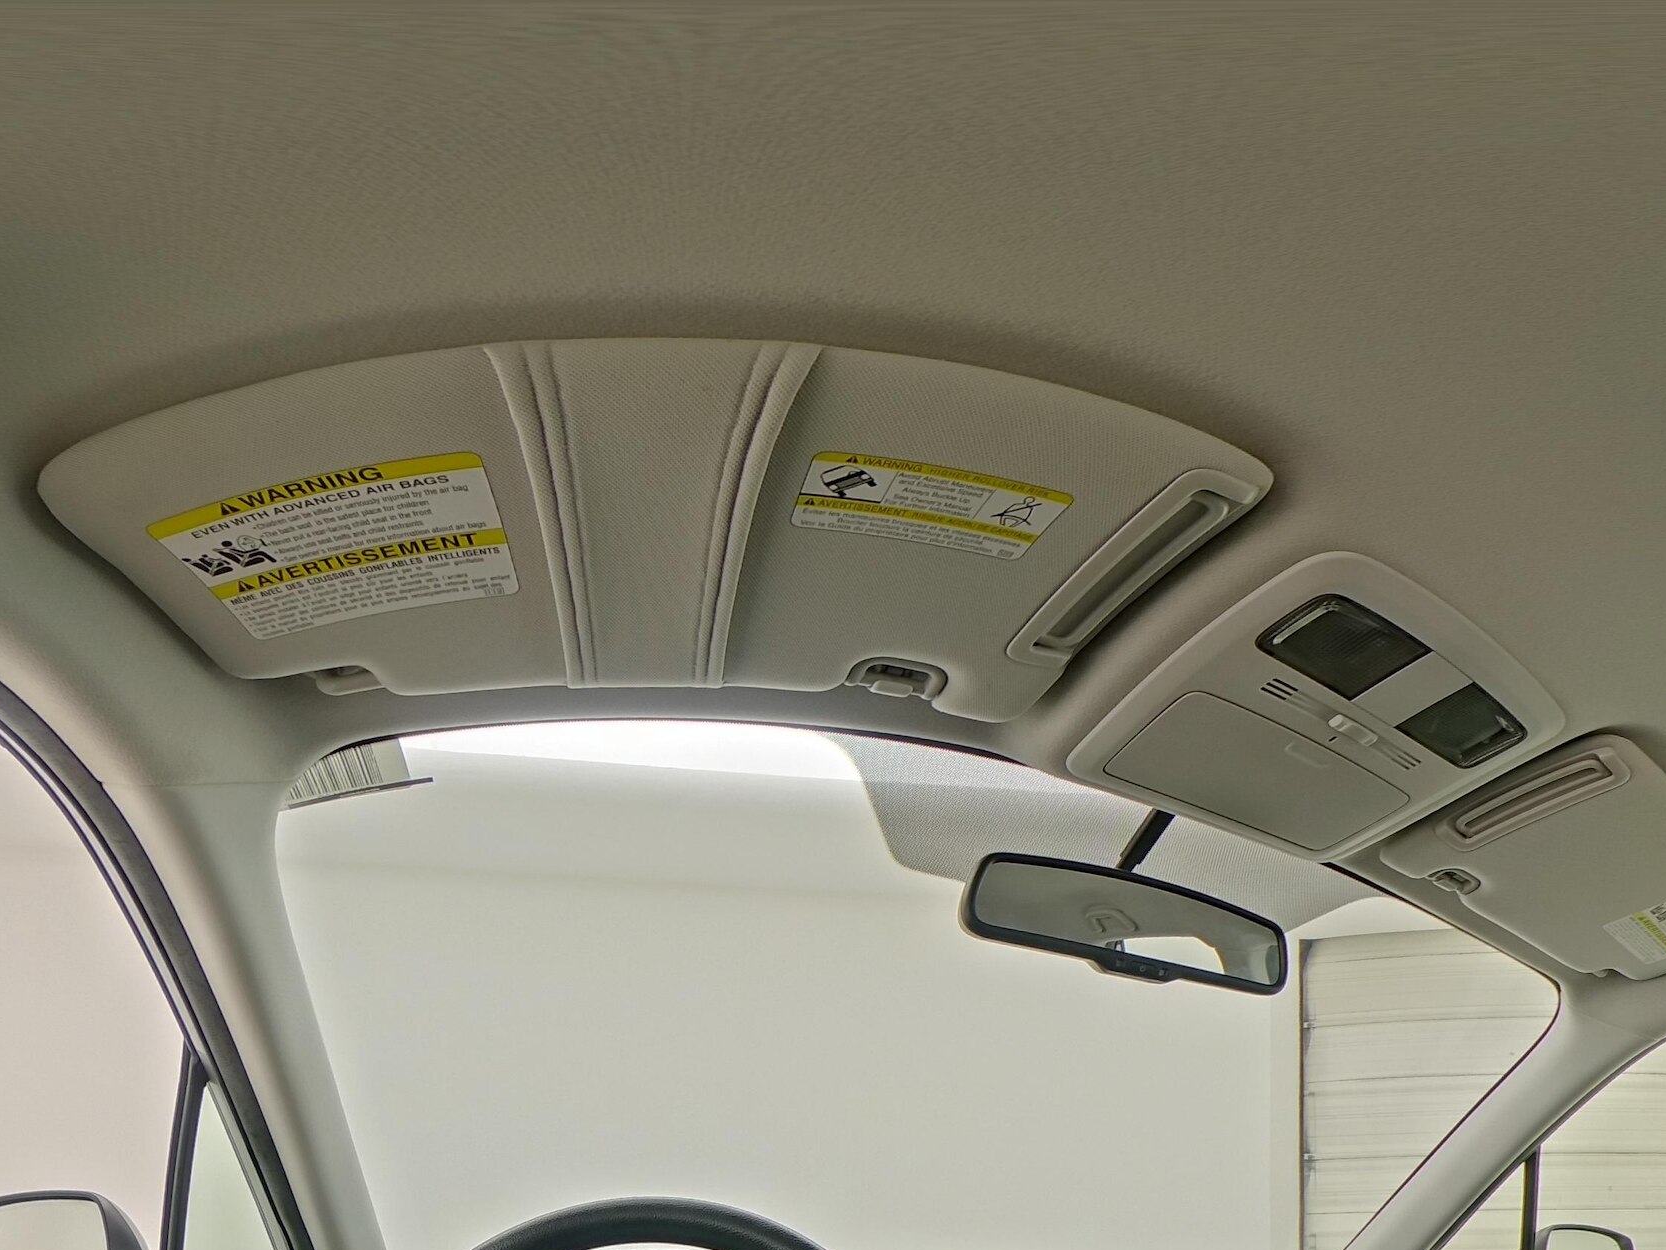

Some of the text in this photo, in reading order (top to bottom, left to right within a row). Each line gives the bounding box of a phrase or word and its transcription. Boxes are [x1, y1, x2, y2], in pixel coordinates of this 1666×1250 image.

[237, 467, 383, 507] WARNING
[863, 458, 1049, 498] WARNING HIGHER ROLLOVER RISK
[382, 492, 411, 502] injured
[412, 490, 423, 498] by
[423, 487, 437, 496] the
[439, 486, 451, 494] air
[452, 484, 469, 493] bag
[191, 475, 450, 538] EVEN WITH ADVANCED AIR BAGS
[362, 506, 383, 518] place
[383, 504, 395, 512] for
[396, 499, 429, 510] children
[817, 498, 907, 516] AVERTISSEMENT
[351, 518, 371, 528] child
[371, 515, 388, 524] seat
[398, 511, 412, 520] the
[413, 508, 433, 518] front
[431, 524, 453, 534] about
[455, 523, 465, 531] air
[467, 520, 487, 530] bags
[353, 530, 366, 538] and
[367, 526, 385, 535] child
[257, 532, 477, 587] AVERTISSEMENT
[260, 586, 283, 598] AVEC
[285, 582, 305, 591] DES
[307, 570, 355, 586] COUSSINS
[359, 557, 423, 575] GONFLABLES
[427, 547, 501, 563] INTELLIGENTS
